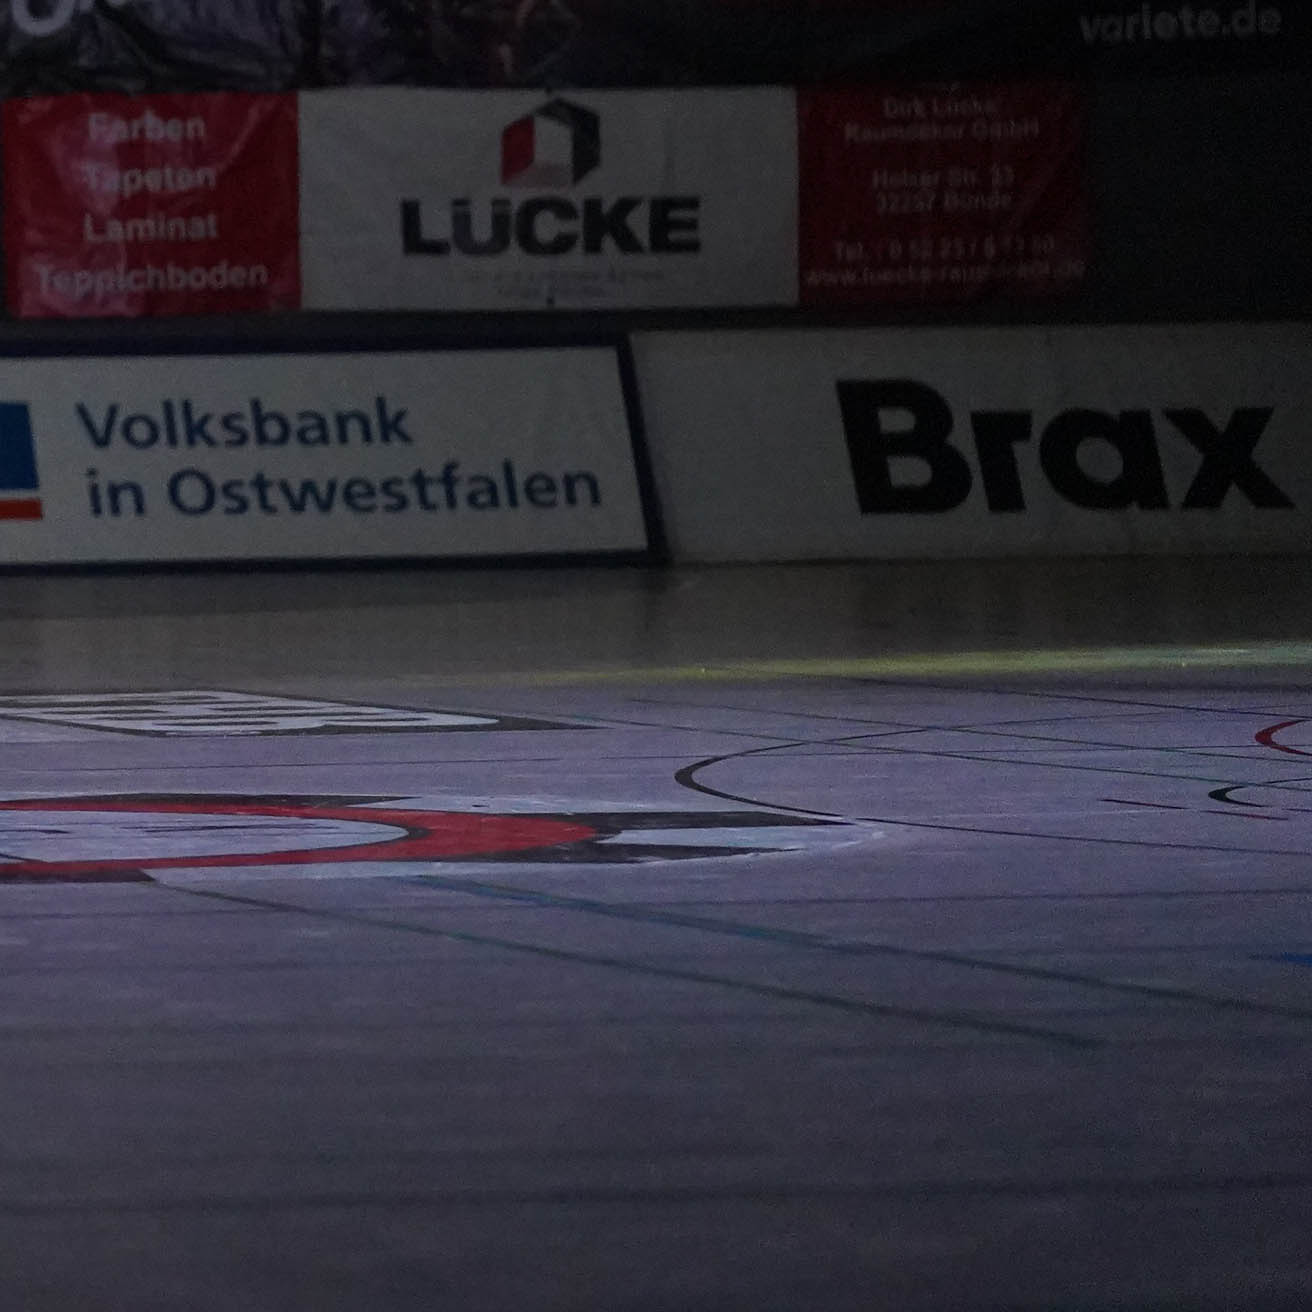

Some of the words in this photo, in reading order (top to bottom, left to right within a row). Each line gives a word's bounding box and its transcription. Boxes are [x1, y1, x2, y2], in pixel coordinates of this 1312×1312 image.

[83, 210, 220, 244] Laminat
[35, 261, 269, 297] Teppichboden
[78, 396, 412, 453] Volksbank
[836, 379, 1296, 514] Brax
[86, 468, 146, 519] in
[169, 459, 602, 518] Ostwestfalen
